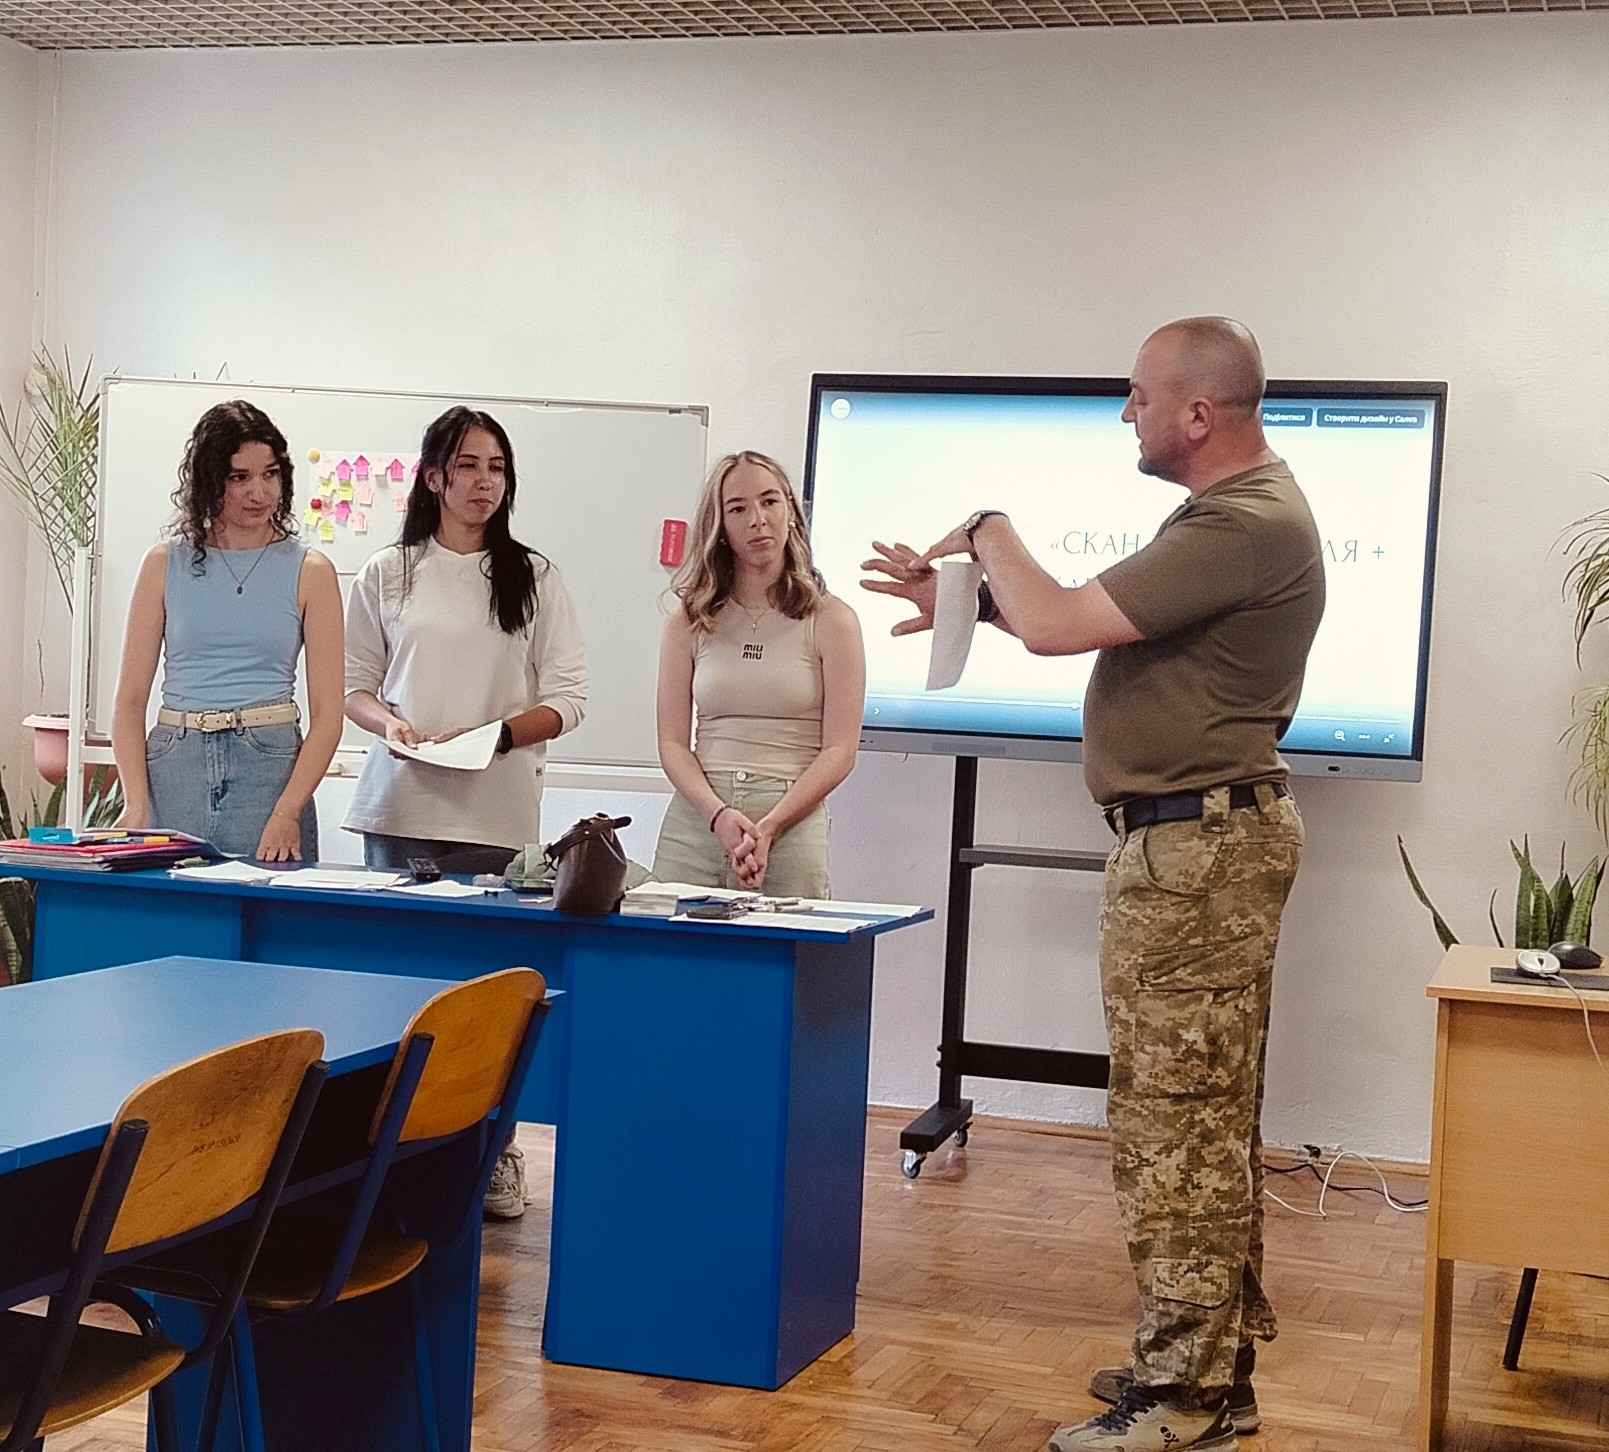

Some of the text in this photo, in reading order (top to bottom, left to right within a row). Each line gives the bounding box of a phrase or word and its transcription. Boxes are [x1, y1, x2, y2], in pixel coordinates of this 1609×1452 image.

[1324, 414, 1360, 423] Створити
[1050, 531, 1140, 556] «СКАН
[1322, 539, 1358, 563] ЛЯ
